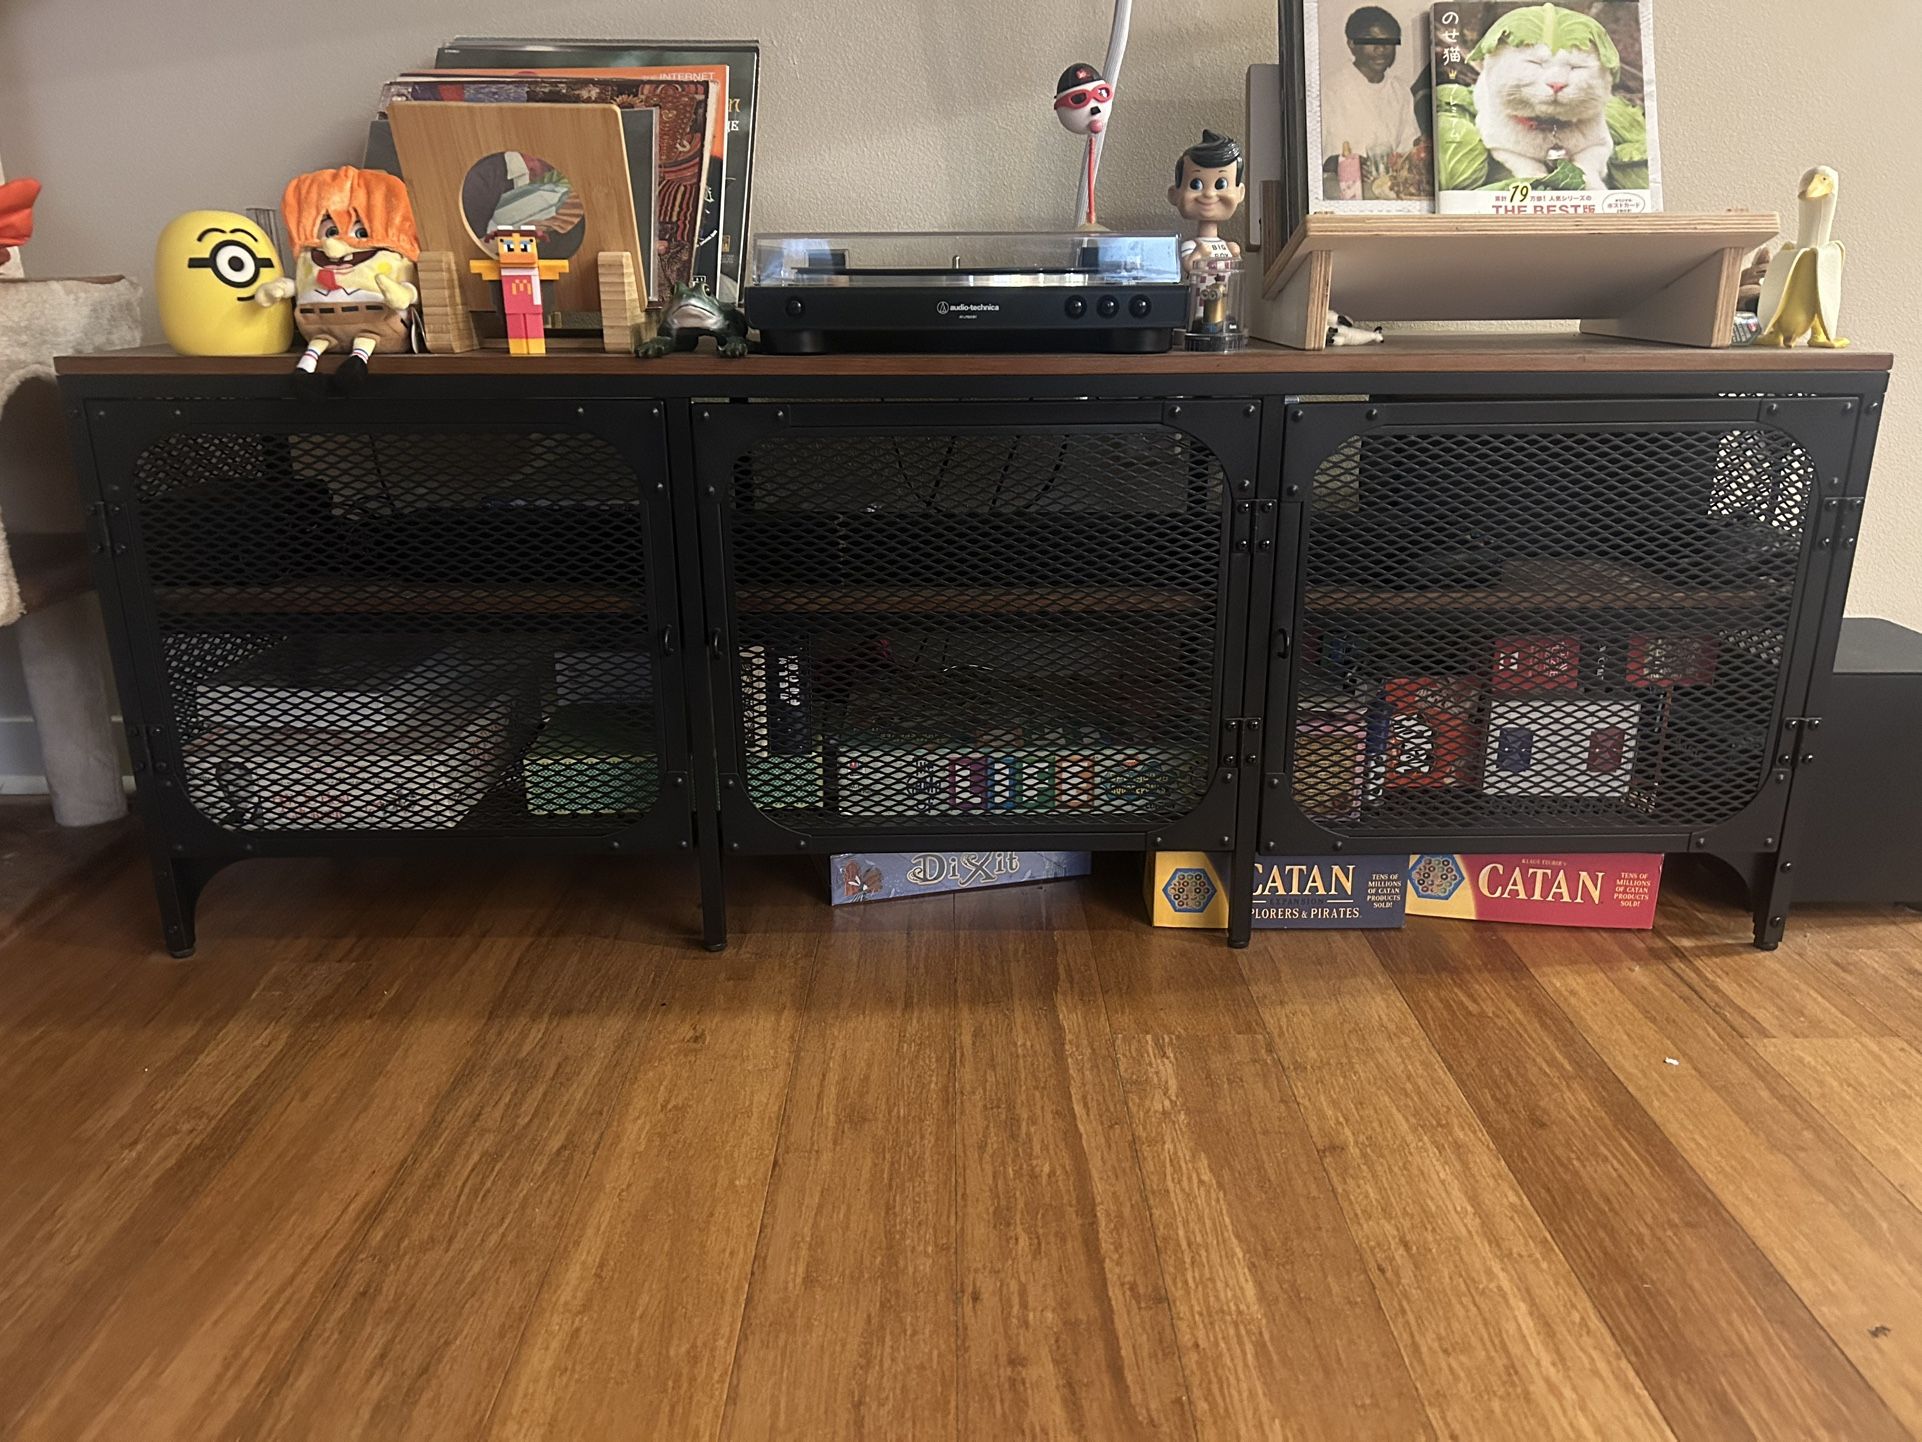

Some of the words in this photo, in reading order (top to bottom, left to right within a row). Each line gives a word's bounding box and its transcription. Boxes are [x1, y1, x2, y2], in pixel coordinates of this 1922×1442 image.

[1442, 12, 1460, 66] のせ猫
[660, 72, 716, 80] INTERNET
[1492, 205, 1527, 213] THE
[1478, 863, 1605, 905] CATAN
[1301, 910, 1307, 919] &
[1310, 907, 1360, 919] PIRATES
